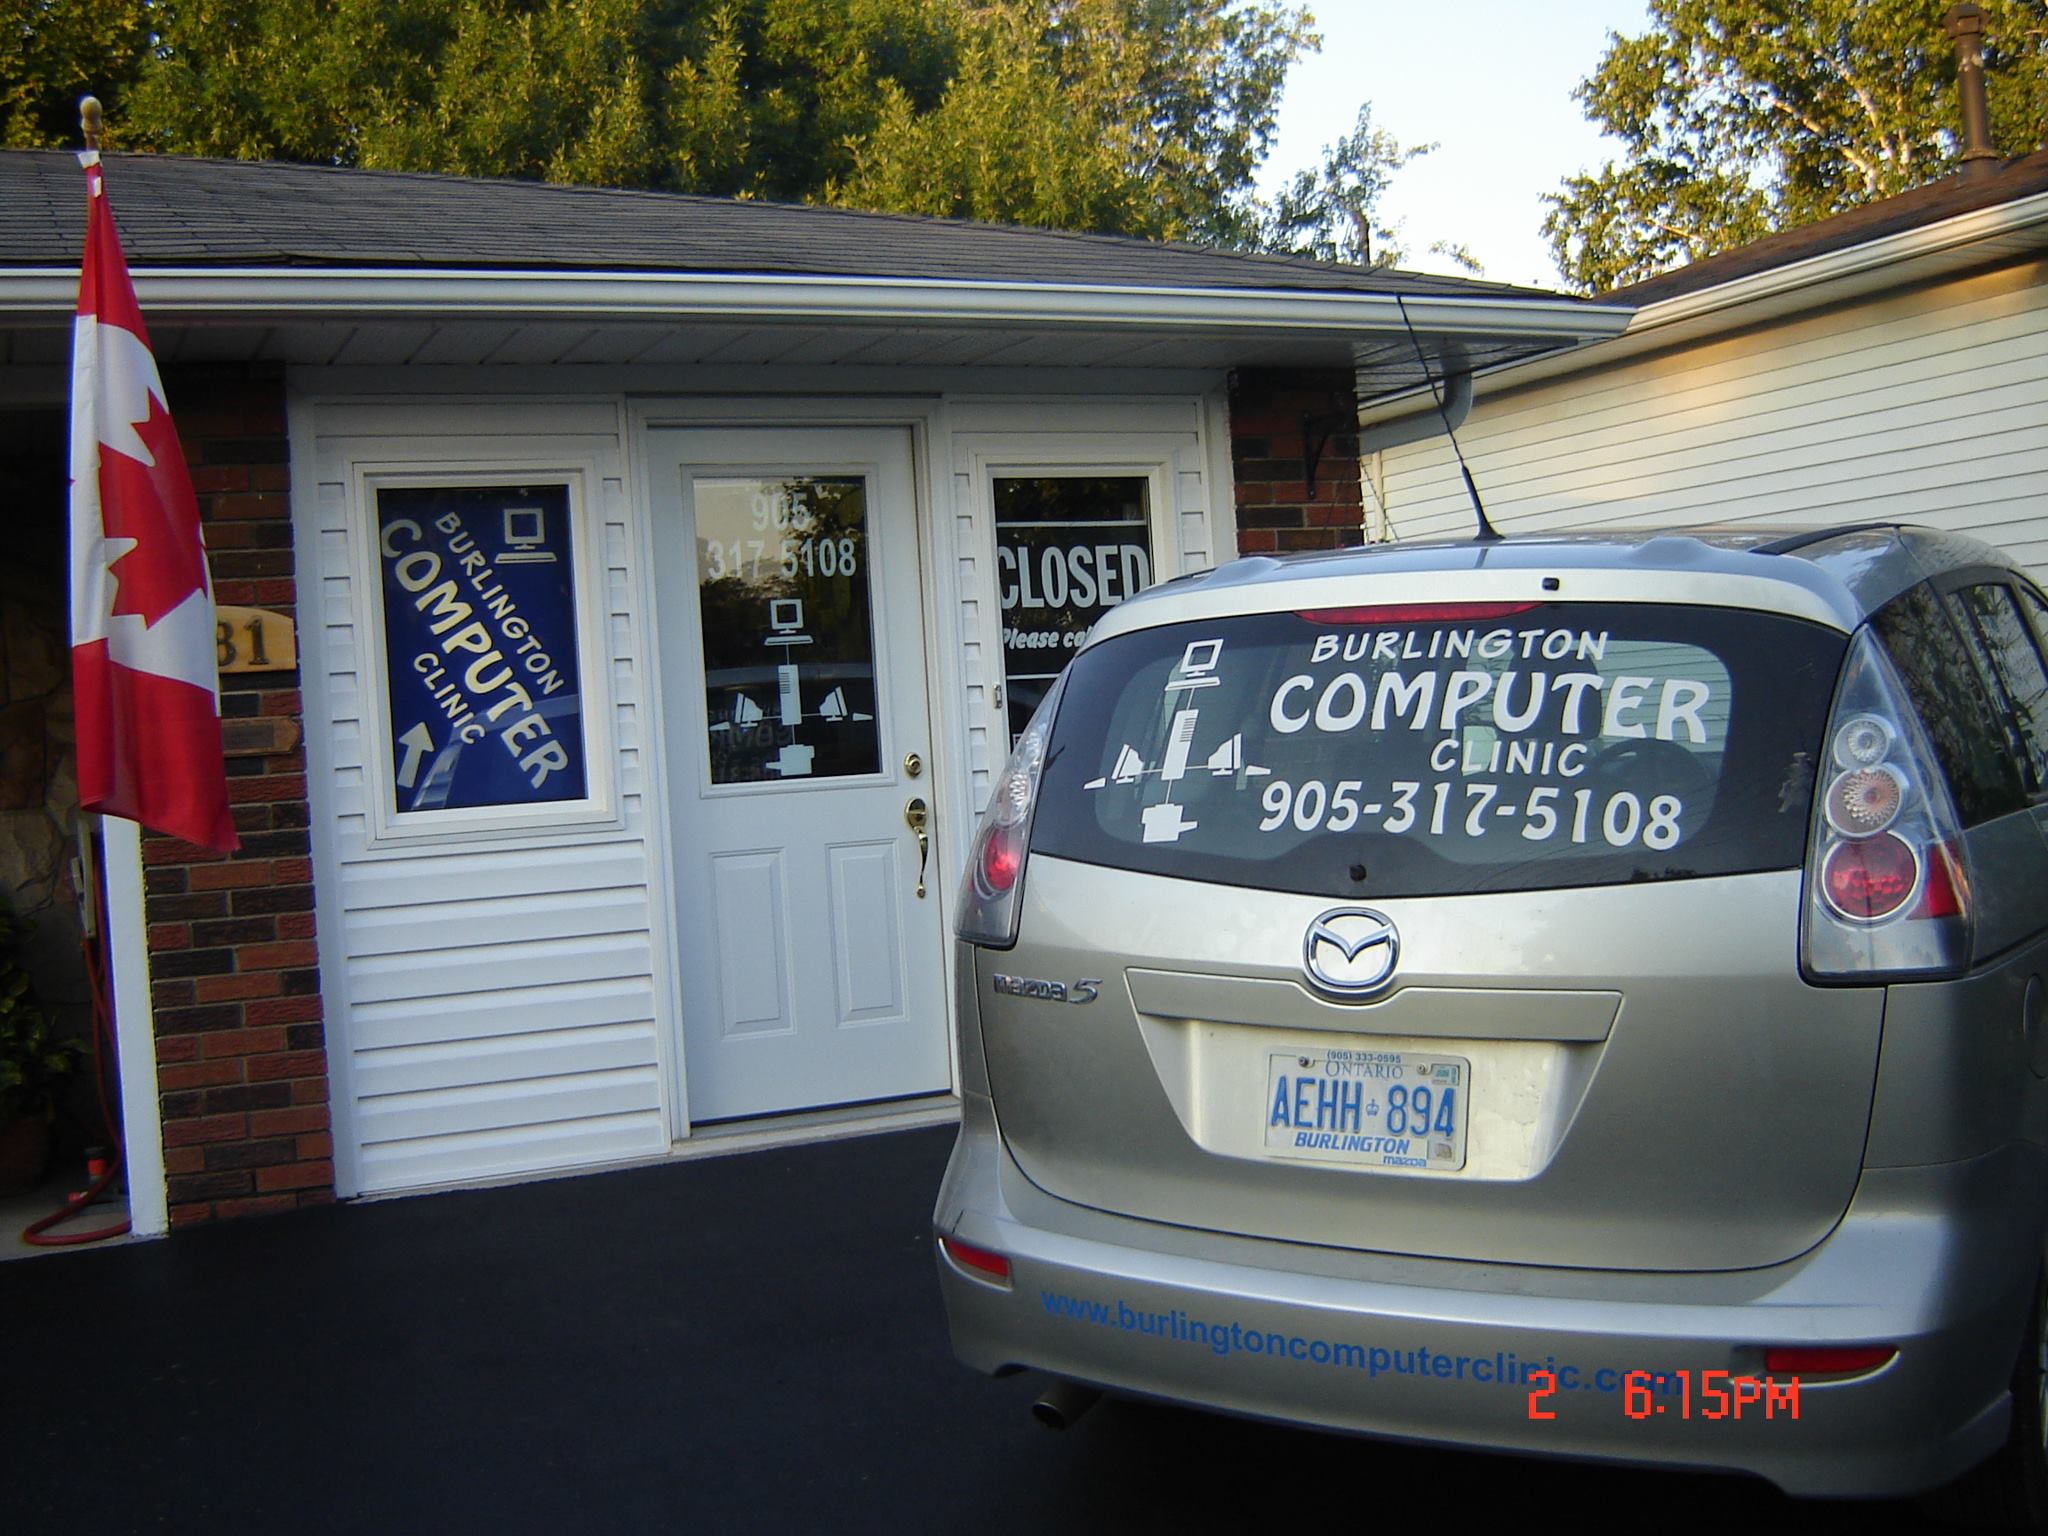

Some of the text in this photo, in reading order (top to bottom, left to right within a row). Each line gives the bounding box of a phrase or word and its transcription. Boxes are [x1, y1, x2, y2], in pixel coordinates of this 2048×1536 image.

[751, 492, 812, 532] 905
[706, 537, 857, 580] 317 5108
[997, 544, 1151, 610] CLOSED
[434, 511, 564, 695] BURLINGTON
[381, 518, 569, 790] COMPUTER
[1002, 627, 1059, 650] Please
[1310, 628, 1608, 664] BURLINGTON
[413, 652, 487, 745] CLINIC
[1268, 670, 1711, 744] COMPUTER
[1429, 738, 1589, 777] CLINIC
[1258, 780, 1683, 850] 905-317-5108
[1270, 1075, 1456, 1138] AEHH 894
[1294, 1131, 1411, 1156] BURLINGTON
